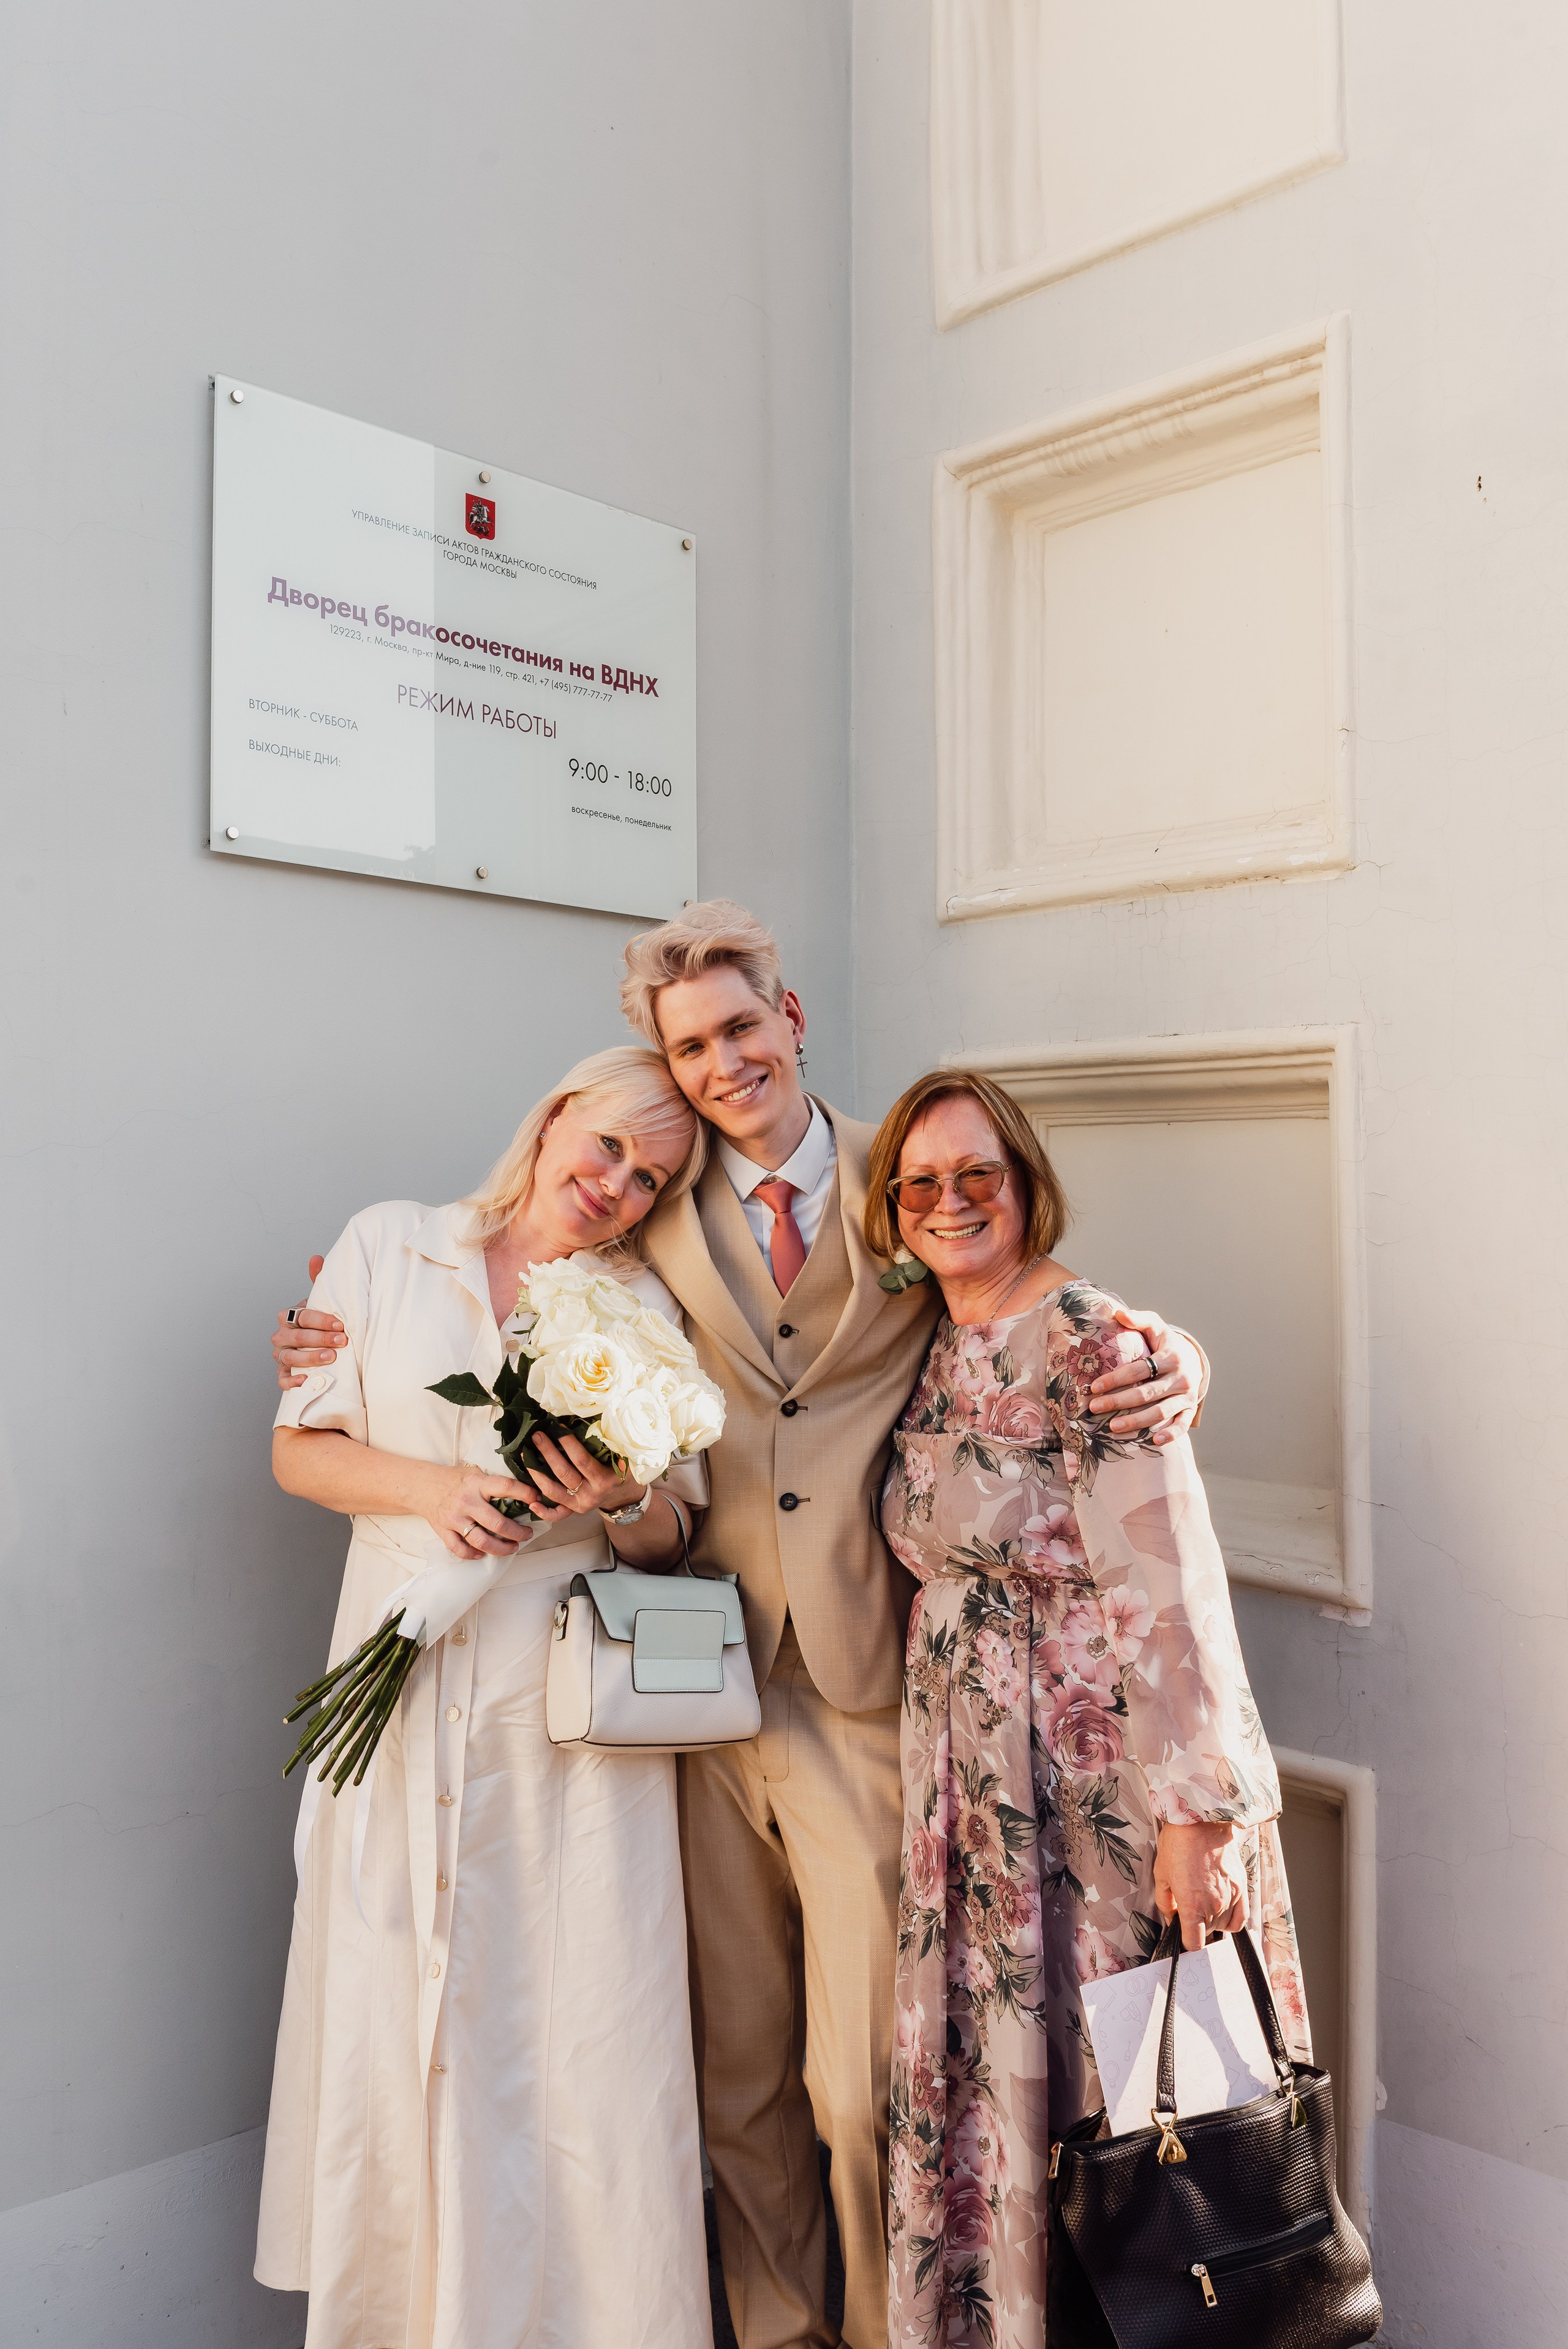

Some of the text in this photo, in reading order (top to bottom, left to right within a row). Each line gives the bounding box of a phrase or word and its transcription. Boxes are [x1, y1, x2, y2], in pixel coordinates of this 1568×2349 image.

[352, 509, 597, 590] УПРАВЛЕНИЕ ЗАПИСИ АКТОВ ГРАЖДАНСКОГО СОСТОЯНИЯ
[443, 550, 518, 579] ГОРОДА МОСКВЫ
[267, 576, 660, 698] Дворец бракосочетания на ВДНХ
[330, 624, 364, 643] 129223,
[374, 636, 410, 654] Москва,
[412, 647, 434, 659] пр-кт
[435, 651, 461, 667] Мира,
[464, 662, 486, 672] д-ние
[489, 664, 503, 678] 119,
[505, 670, 520, 681] стр.
[522, 673, 537, 685] 421,
[539, 677, 549, 687] +7
[551, 679, 571, 695] (495)
[573, 685, 613, 703] 777-77-77
[249, 698, 300, 719] ВТОРНИК
[310, 712, 358, 731] СУББОТА
[398, 684, 557, 739] РЕЖИМ РАБОТЫ
[249, 739, 341, 767] ВЫХОДНЫЕ ДНИ:
[568, 758, 608, 783] 9:00
[628, 771, 672, 797] 18:00
[571, 806, 673, 832] воскресенье, понедельник
